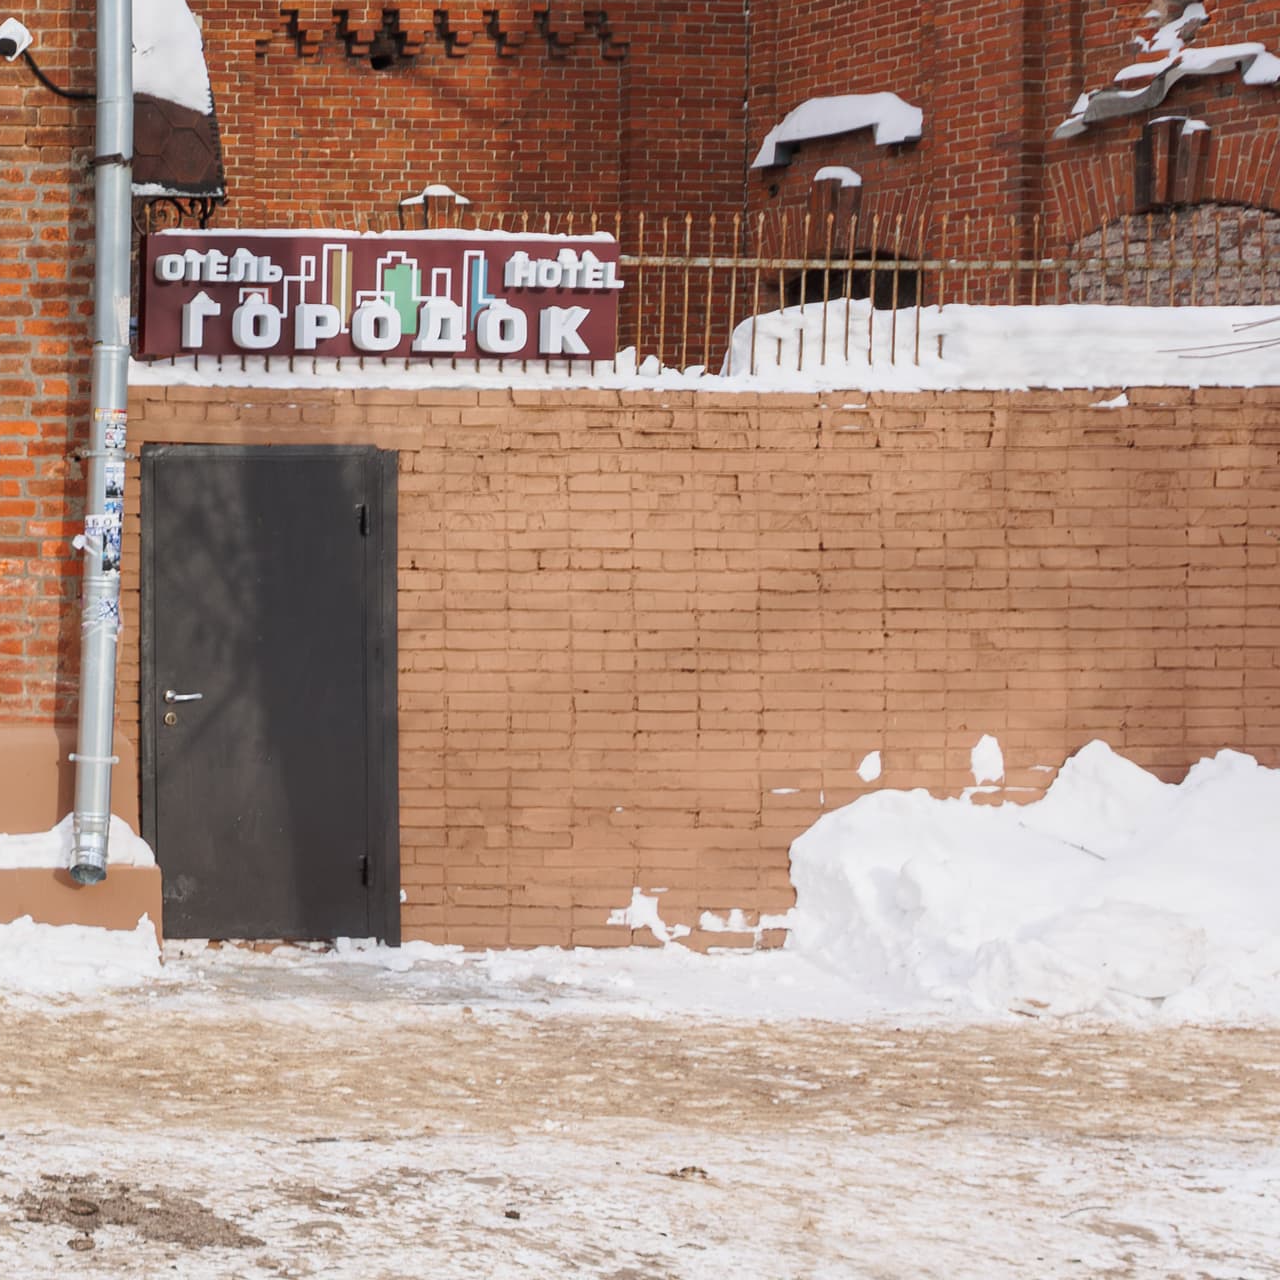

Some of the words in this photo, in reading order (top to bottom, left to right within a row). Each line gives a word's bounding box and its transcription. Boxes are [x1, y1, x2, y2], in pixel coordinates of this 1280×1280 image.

[155, 251, 283, 284] ОТЕЛЬ
[504, 255, 624, 289] HOTEL
[181, 297, 590, 355] ГОРОДОК
